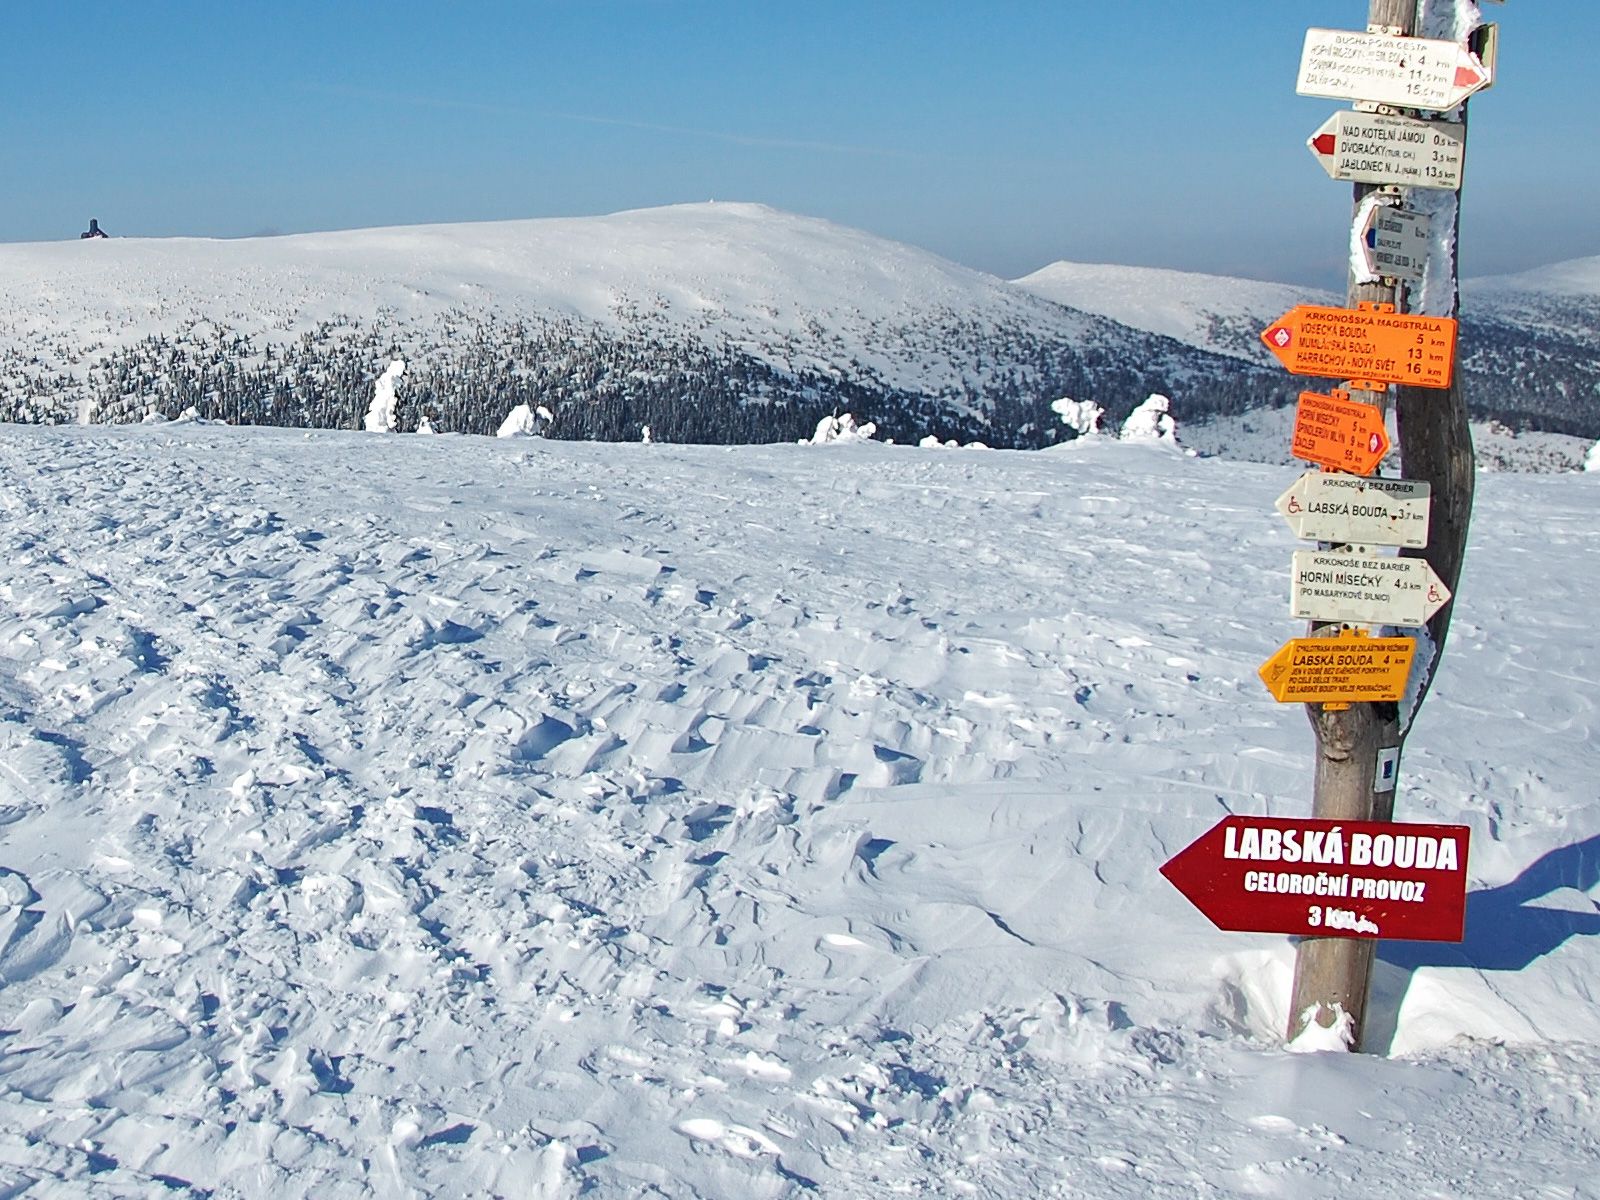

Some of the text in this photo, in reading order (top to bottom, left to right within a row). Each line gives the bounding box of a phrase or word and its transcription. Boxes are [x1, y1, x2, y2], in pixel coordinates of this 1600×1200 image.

[1342, 126, 1360, 138] NAD
[1362, 128, 1396, 142] KOTELNÍ
[1398, 128, 1426, 144] JÁMOU
[1433, 134, 1446, 146] 0,5
[1341, 142, 1384, 156] DVORAČKY
[1432, 150, 1444, 162] 3,5
[1340, 158, 1384, 172] JABLONEC
[1425, 166, 1443, 178] 13,5
[1444, 171, 1456, 179] km
[1306, 312, 1442, 332] KRKONOŠSKÁ MAGISTRÁLA
[1340, 326, 1367, 339] BOUDA
[1416, 334, 1424, 344] 5
[1431, 338, 1445, 346] km
[1349, 341, 1376, 354] BOUDA
[1408, 347, 1422, 360] 13
[1430, 353, 1444, 362] km
[1296, 352, 1346, 366] HARRACHOV
[1352, 356, 1374, 369] NOVÝ
[1376, 358, 1396, 372] SVĚT
[1406, 362, 1422, 374] 16
[1428, 368, 1442, 376] km
[1352, 421, 1358, 432] 5
[1368, 482, 1384, 491] BEZ
[1308, 502, 1349, 516] LABSKÁ
[1352, 505, 1388, 518] BOUDA
[1398, 508, 1411, 520] 3,7
[1314, 558, 1359, 568] KRKONOŠE
[1362, 561, 1378, 570] BEZ
[1300, 570, 1422, 590] HORNÍ MÍSEČKY 4,5 km
[1300, 588, 1312, 596] (PO
[1293, 654, 1334, 666] LABSKÁ
[1337, 655, 1372, 666] BOUDA
[1384, 655, 1390, 664] 4
[1224, 826, 1458, 870] LABSKÁ BOUDA
[1244, 871, 1426, 902] CELOROČNÍ PROVOZ
[1308, 906, 1322, 926] 3
